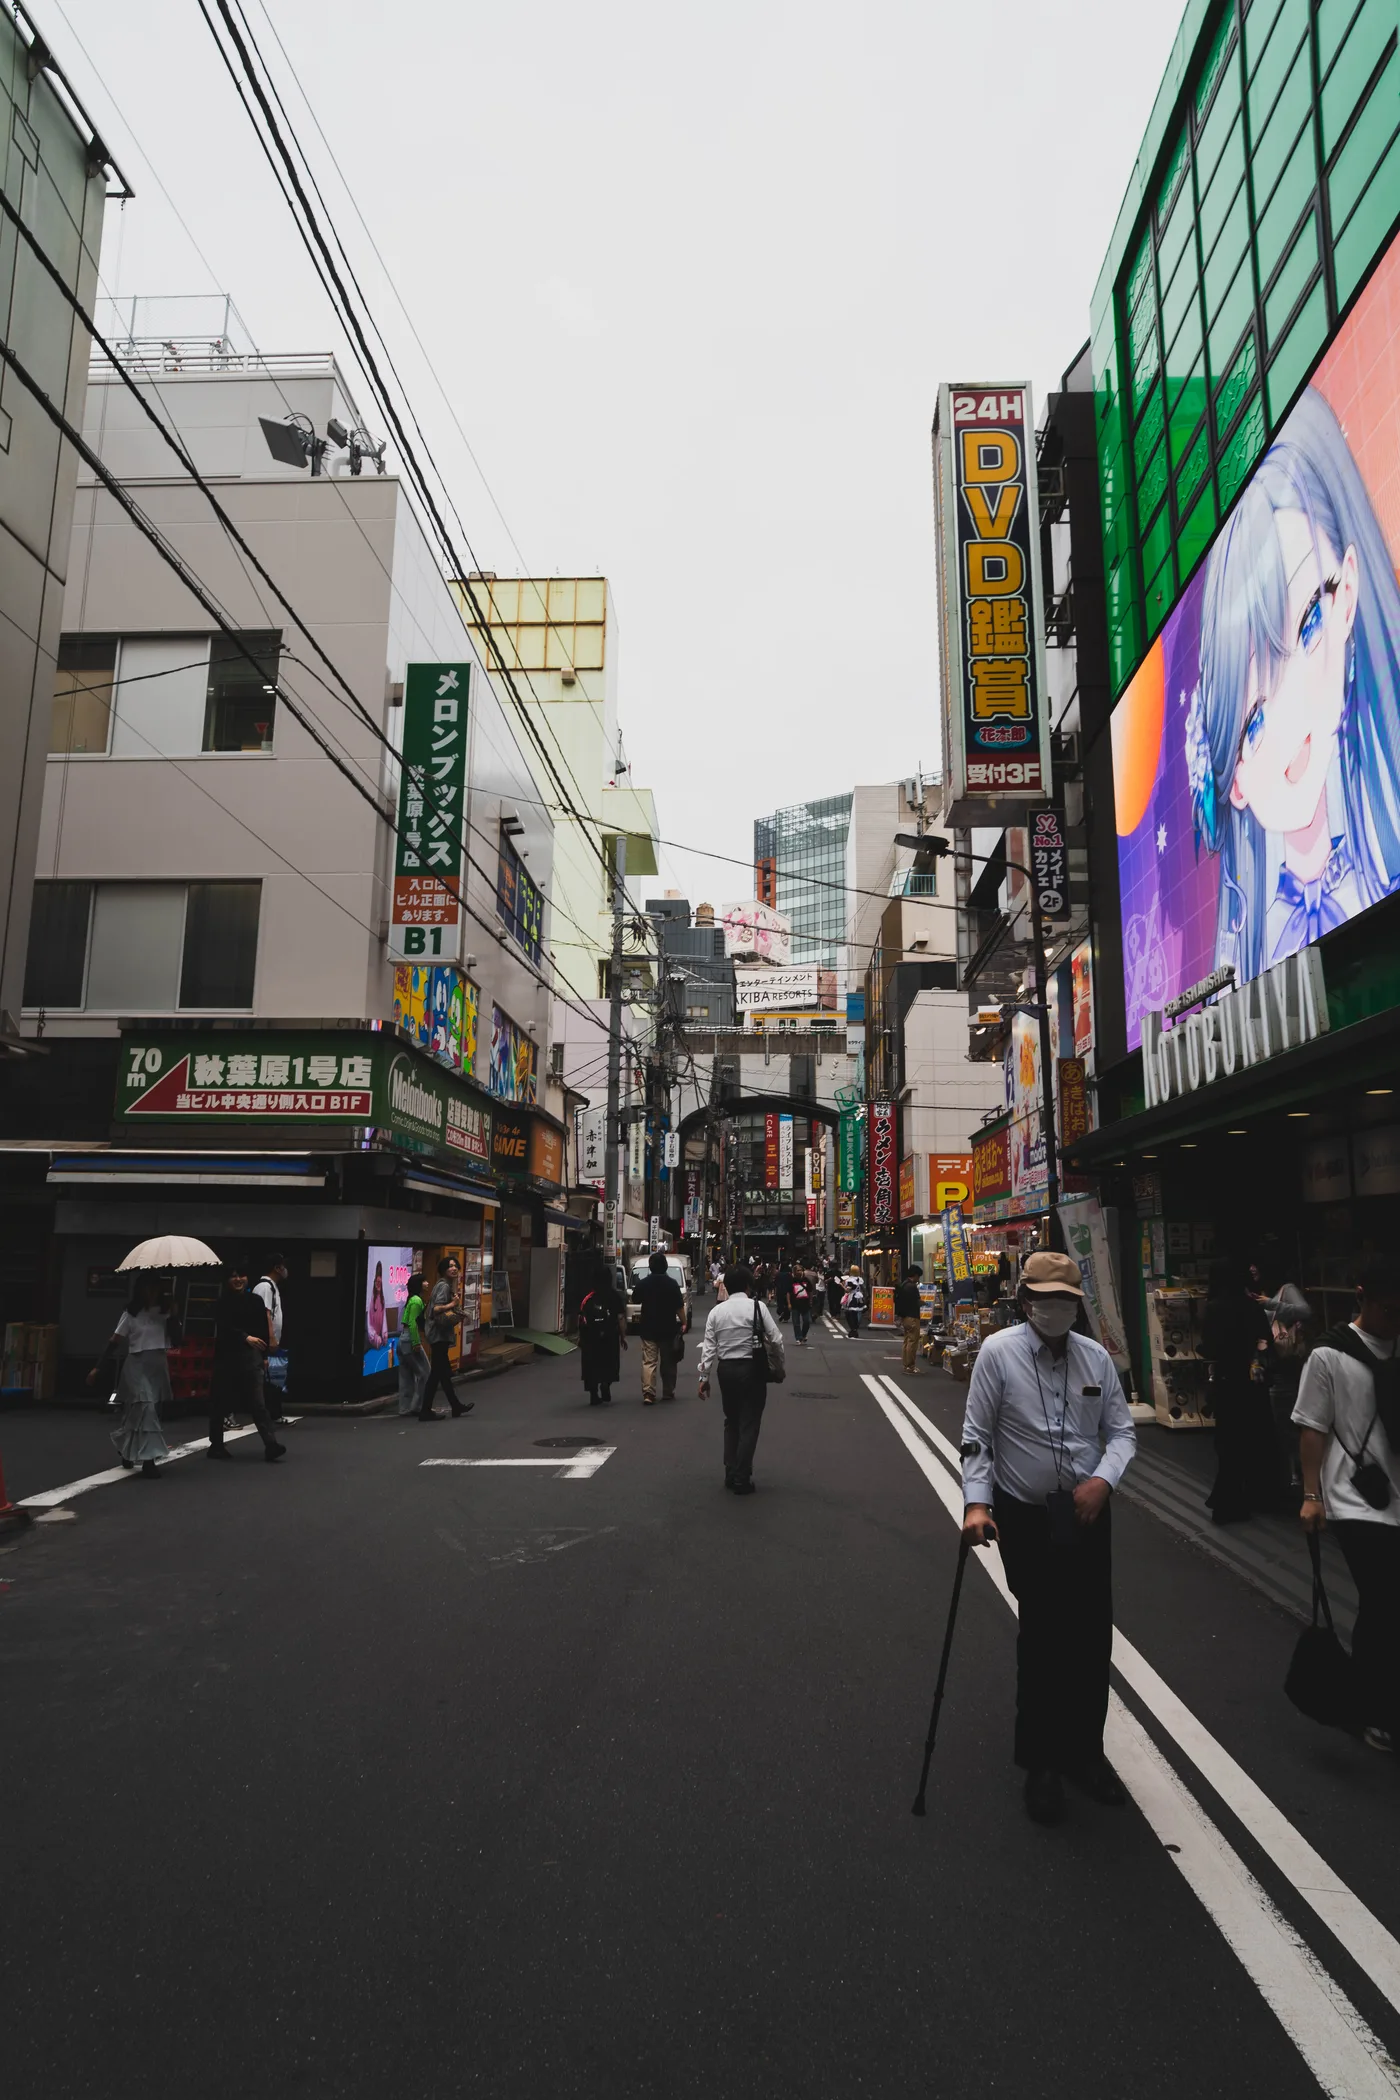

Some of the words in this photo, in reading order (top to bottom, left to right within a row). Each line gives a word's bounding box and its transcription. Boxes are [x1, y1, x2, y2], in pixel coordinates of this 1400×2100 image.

[954, 395, 1022, 421] 24H
[427, 669, 460, 867] メロンブックス
[967, 762, 1041, 785] 受付3F
[402, 764, 426, 868] 秋葉原1号店
[1034, 833, 1063, 848] No.1
[1035, 849, 1048, 887] カフェ
[1050, 849, 1064, 888] メイド
[408, 878, 447, 892] 入口は
[396, 892, 457, 907] ビル正面に
[1042, 893, 1059, 909] 2F
[401, 908, 450, 923] あります。
[403, 926, 442, 955] B1
[772, 989, 813, 1001] RESORTS
[1163, 964, 1236, 1017] CRAFTSMANSHIP
[1141, 946, 1328, 1110] KOTOBUKIYA
[128, 1047, 163, 1073] 70
[194, 1054, 372, 1088] 秋葉原1号店
[126, 1072, 146, 1087] m
[176, 1093, 326, 1111] 当ビル中央通り側入口
[329, 1095, 362, 1111] B1F
[391, 1067, 443, 1129] Melonbooks
[494, 1135, 527, 1158] GAME
